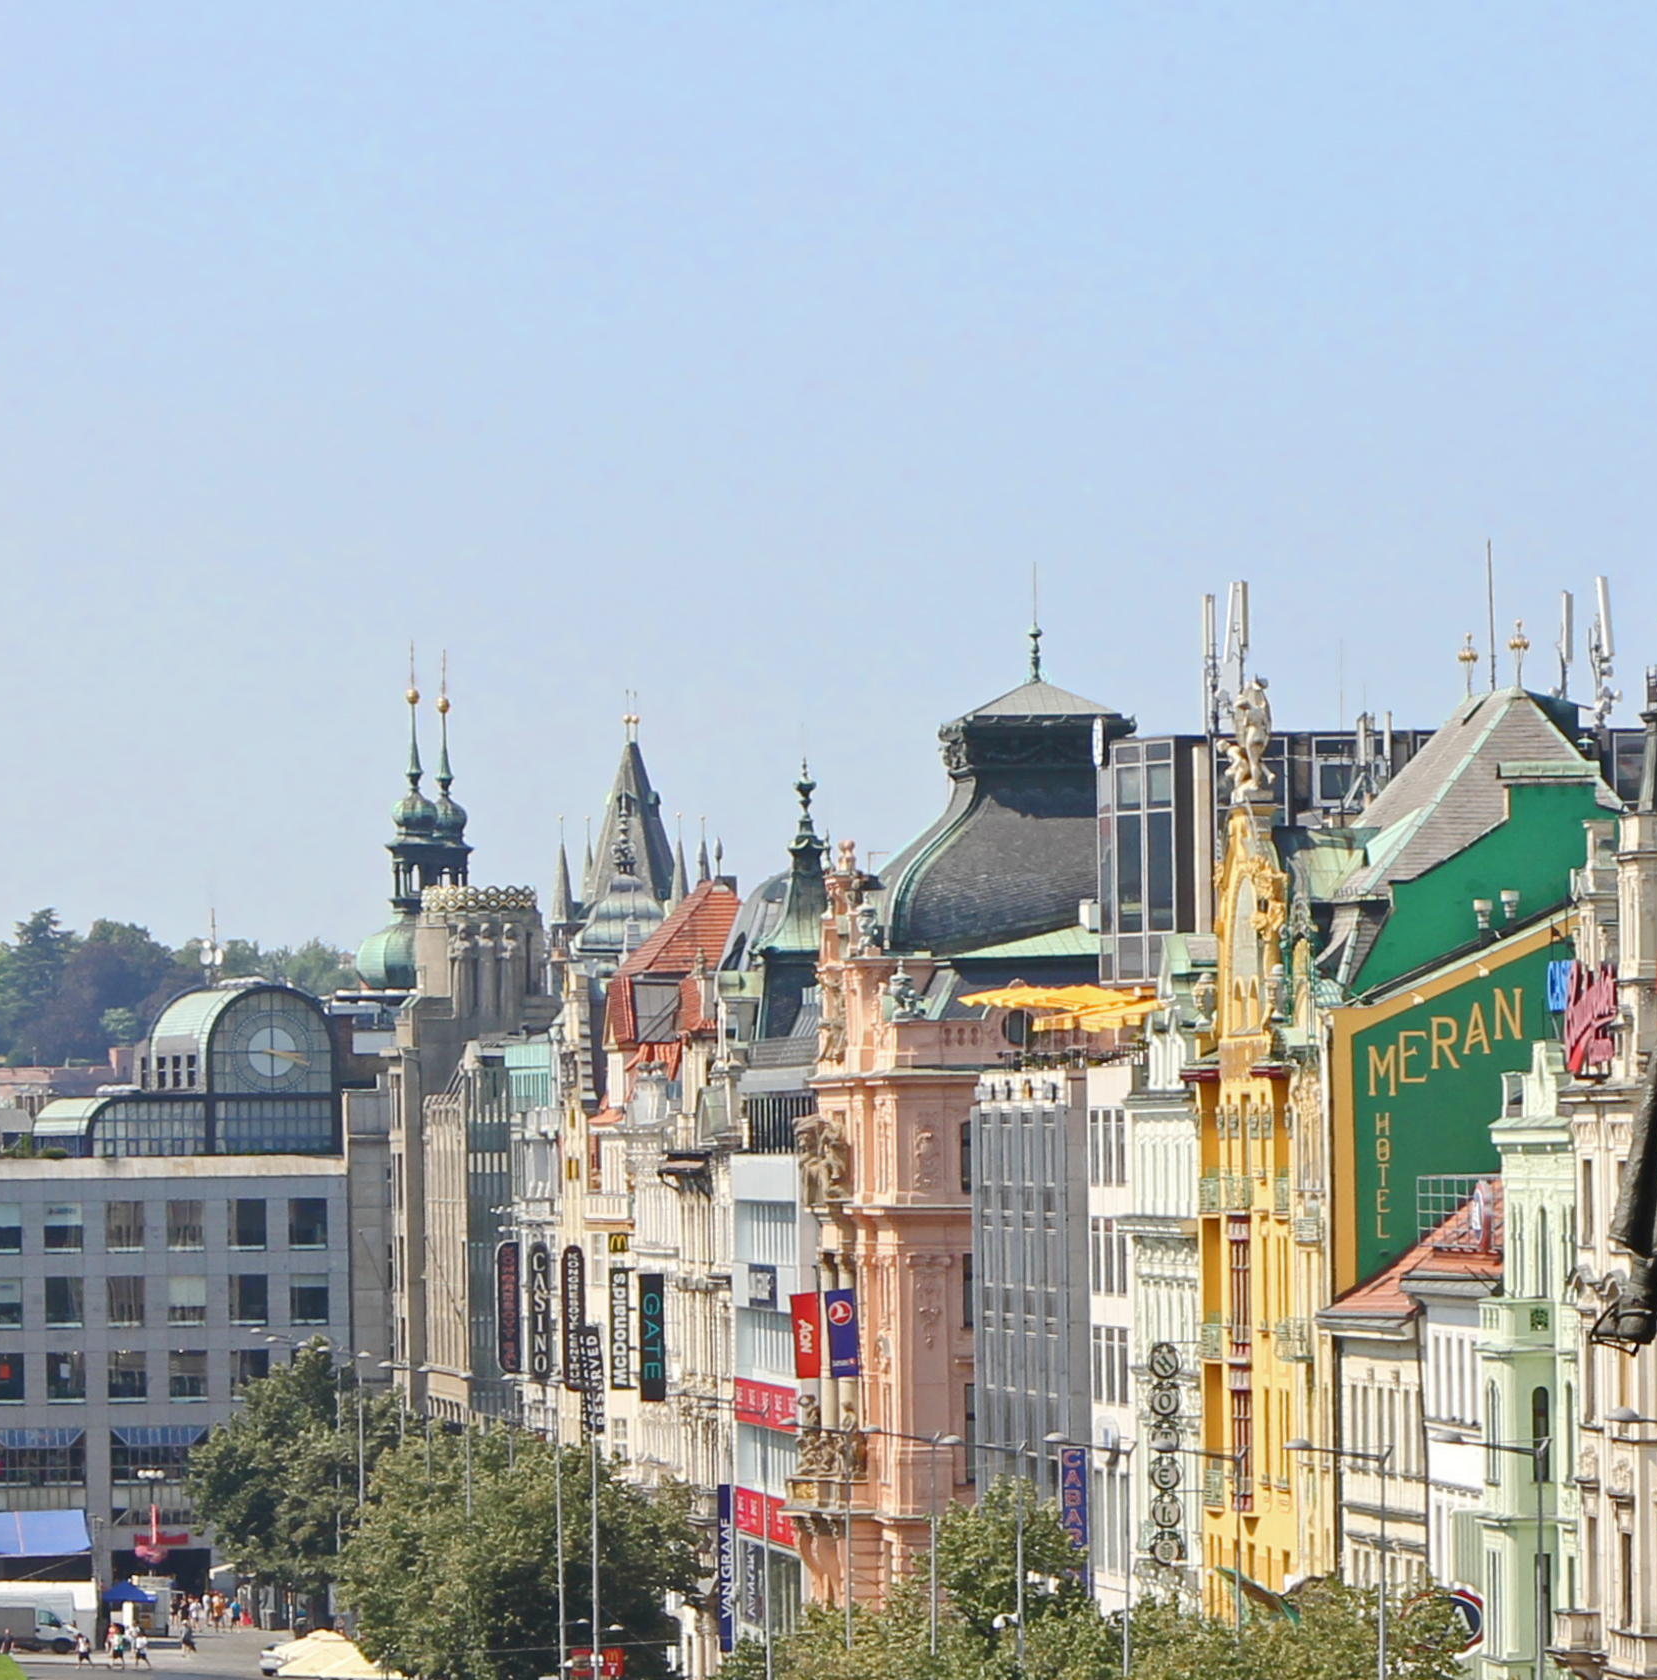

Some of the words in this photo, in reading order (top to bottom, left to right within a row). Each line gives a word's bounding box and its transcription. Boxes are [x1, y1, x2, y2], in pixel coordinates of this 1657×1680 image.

[1368, 988, 1523, 1096] MERAN
[1375, 1112, 1391, 1239] HOTEL
[533, 1252, 547, 1372] CASINO
[612, 1272, 627, 1385] McDonald's
[644, 1292, 661, 1380] GATE
[1156, 1357, 1175, 1521] HOTEL
[720, 1518, 733, 1579] GRAAF
[1063, 1451, 1083, 1578] CABAR
[721, 1583, 734, 1618] VAN
